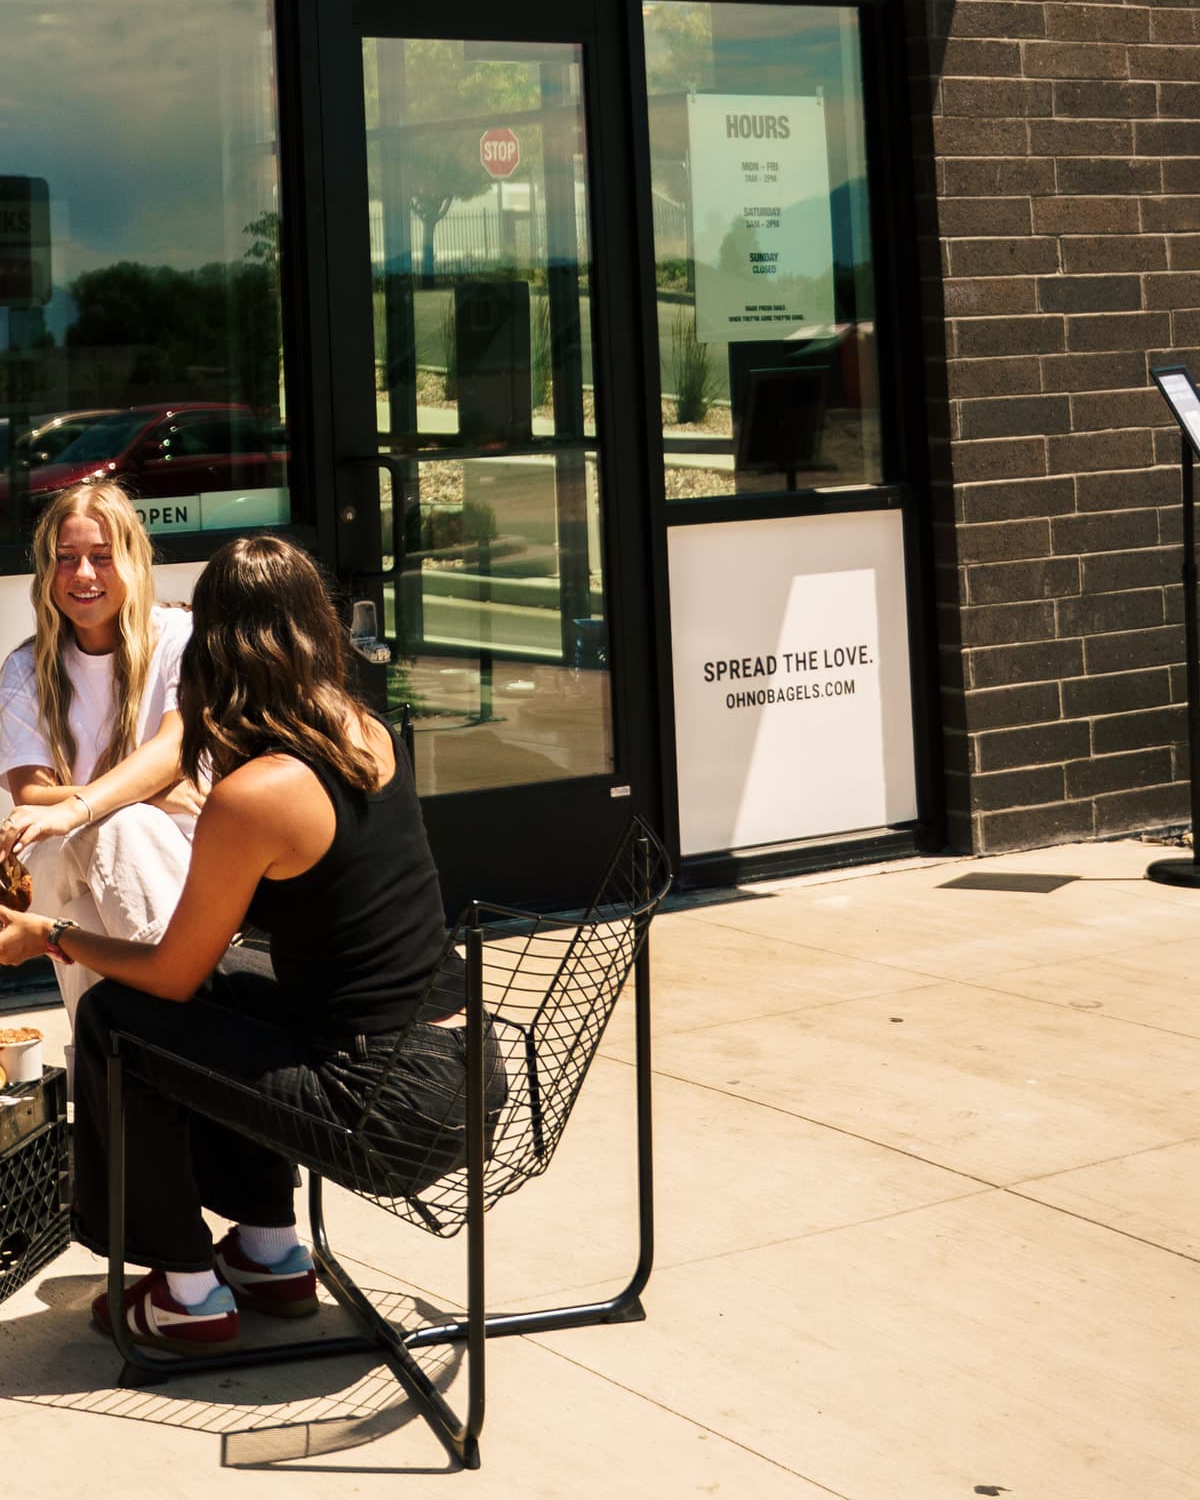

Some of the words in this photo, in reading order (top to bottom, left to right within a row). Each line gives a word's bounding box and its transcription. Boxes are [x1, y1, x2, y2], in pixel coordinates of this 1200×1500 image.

[726, 114, 790, 139] HOURS
[484, 140, 516, 162] STOP
[742, 162, 759, 172] MON
[767, 162, 778, 172] FRI
[744, 207, 781, 216] SATURDAY
[749, 252, 779, 263] SUNDAY
[752, 265, 776, 274] CLOSED
[703, 655, 778, 682] SPREAD
[783, 650, 818, 673] THE
[823, 645, 873, 669] LOVE.
[726, 679, 856, 709] OHNOBAGELS.COM
